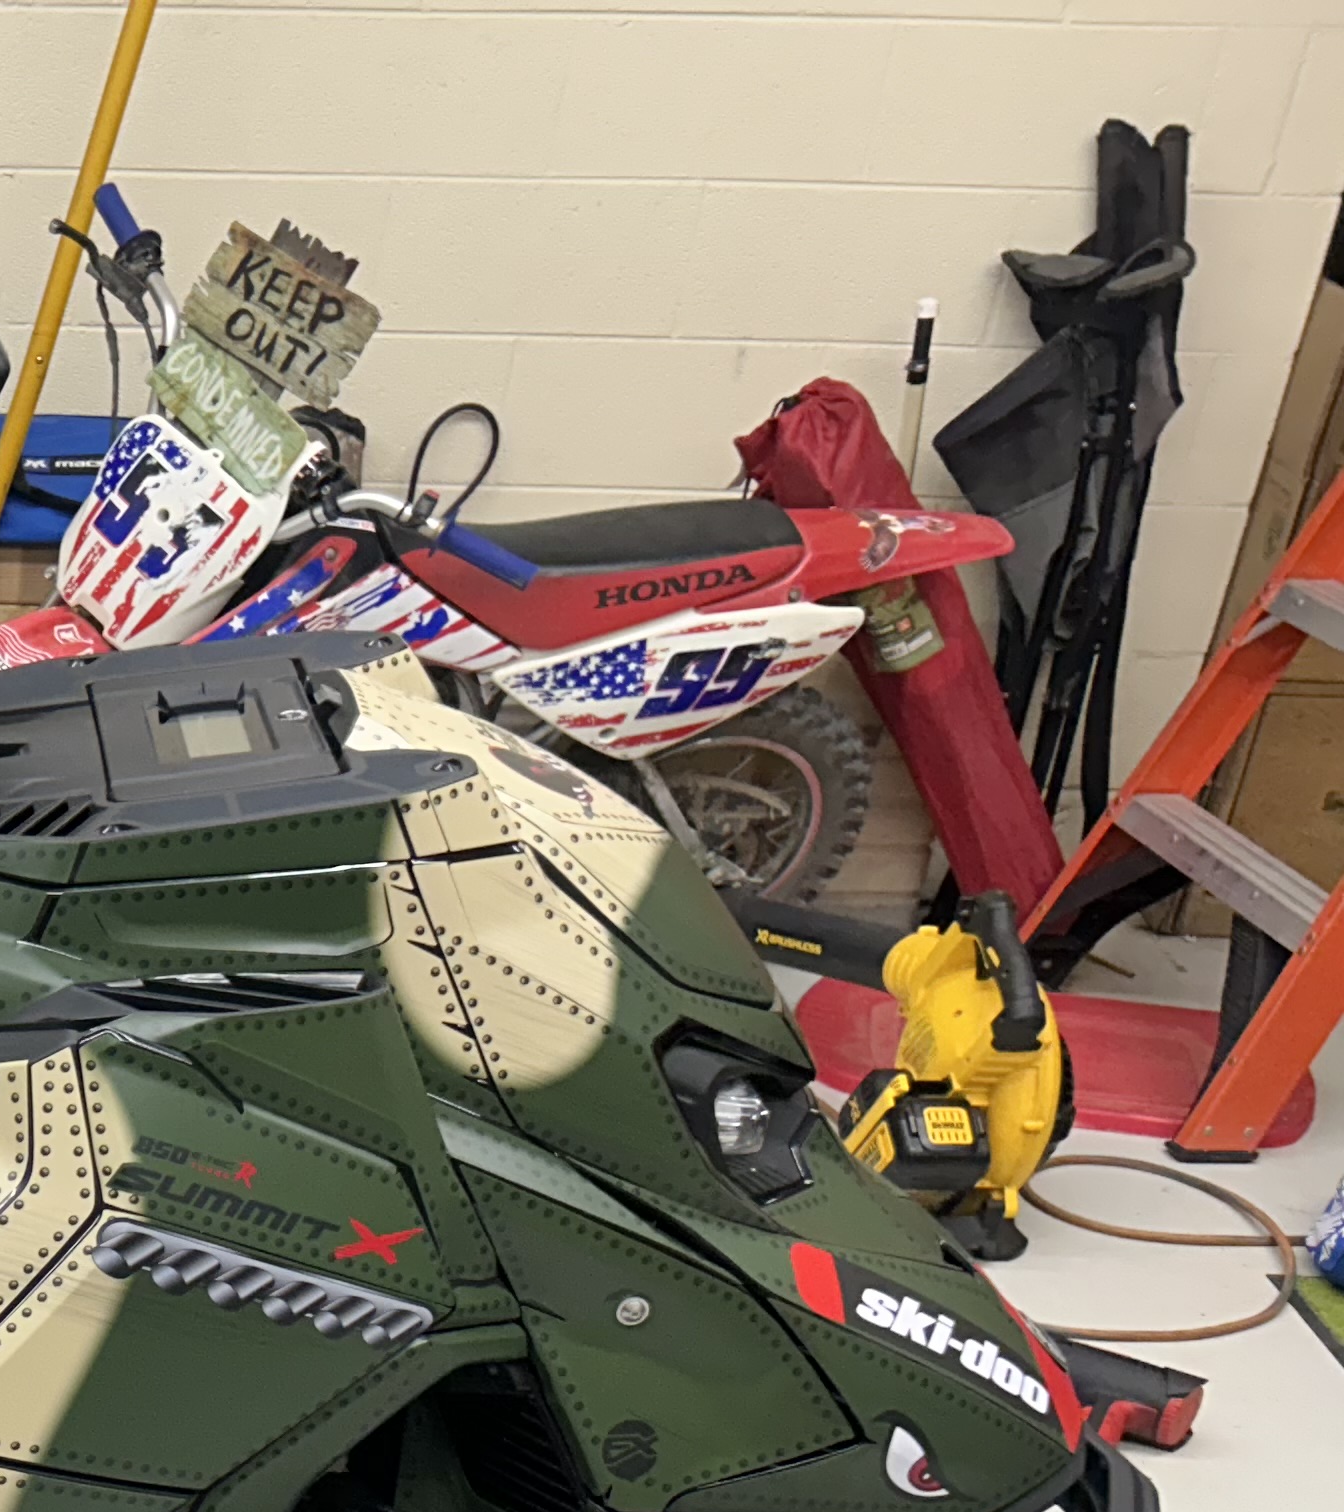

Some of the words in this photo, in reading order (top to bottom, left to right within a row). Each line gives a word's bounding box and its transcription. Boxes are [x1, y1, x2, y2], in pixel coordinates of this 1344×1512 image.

[226, 249, 345, 335] KEEP
[225, 307, 328, 387] OUT!
[165, 342, 284, 481] CONDEMNED
[594, 563, 756, 609] HONDA
[130, 1135, 191, 1165] 850
[105, 1162, 341, 1241] SUMMIT
[333, 1216, 426, 1266] X
[855, 1287, 1051, 1416] ski-doo
